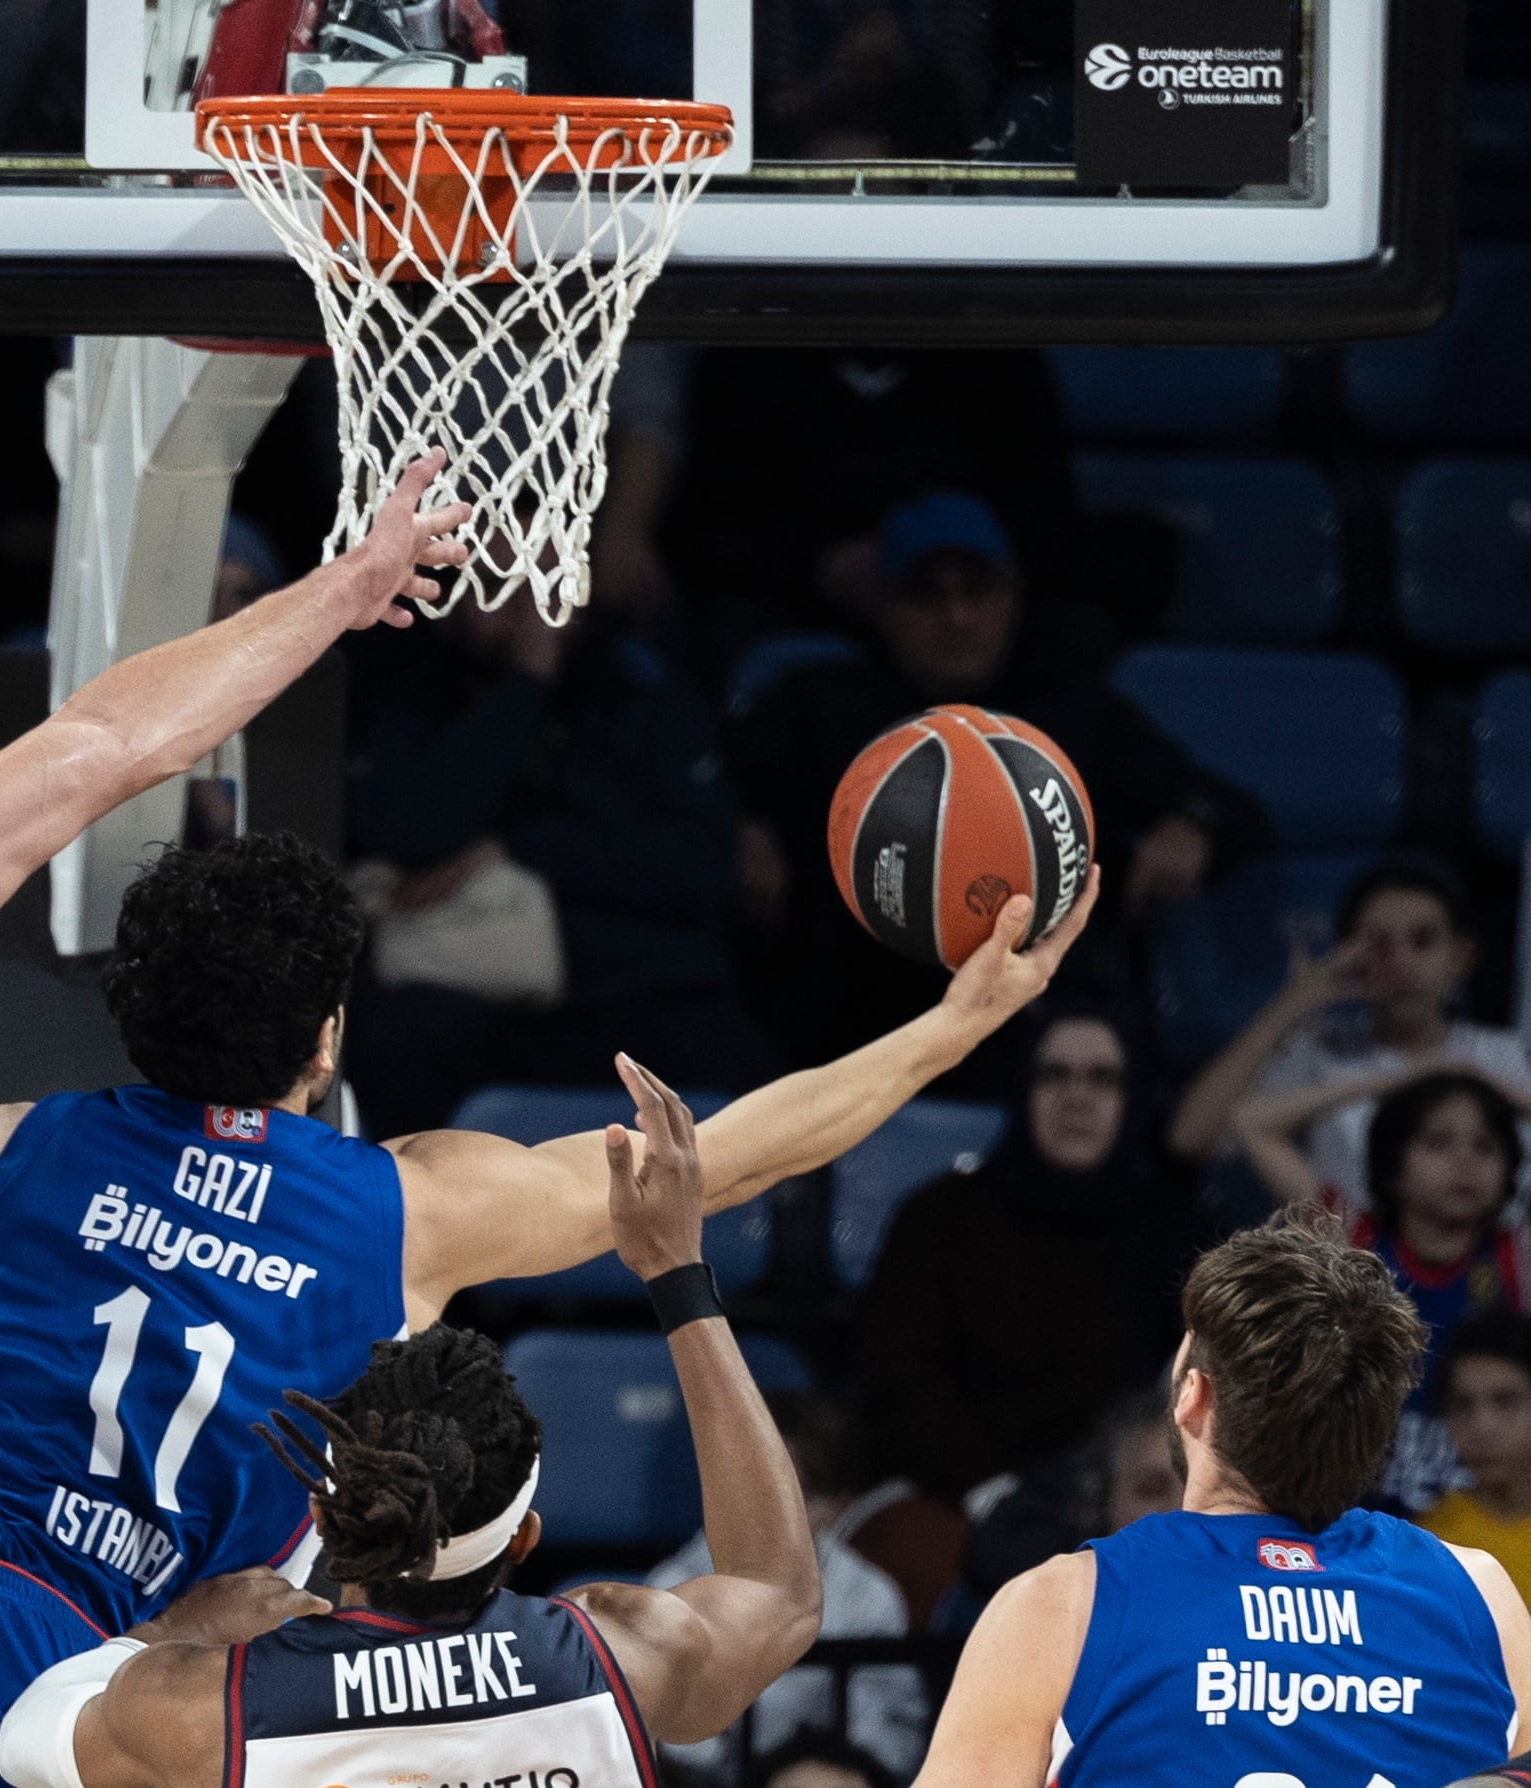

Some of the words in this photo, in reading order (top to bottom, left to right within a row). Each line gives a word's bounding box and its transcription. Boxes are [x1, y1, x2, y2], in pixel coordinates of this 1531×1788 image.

[1137, 47, 1214, 63] Euroleague
[1215, 48, 1283, 61] Basketball
[1137, 62, 1283, 89] oneteam
[1182, 94, 1230, 105] TURKISH
[1232, 94, 1283, 105] AIRLINES
[78, 1184, 318, 1300] Bilyoner
[88, 1284, 236, 1514] 11
[1239, 1585, 1363, 1645] DAUM
[333, 1631, 536, 1719] MONEKE
[1196, 1648, 1422, 1727] Bilyoner
